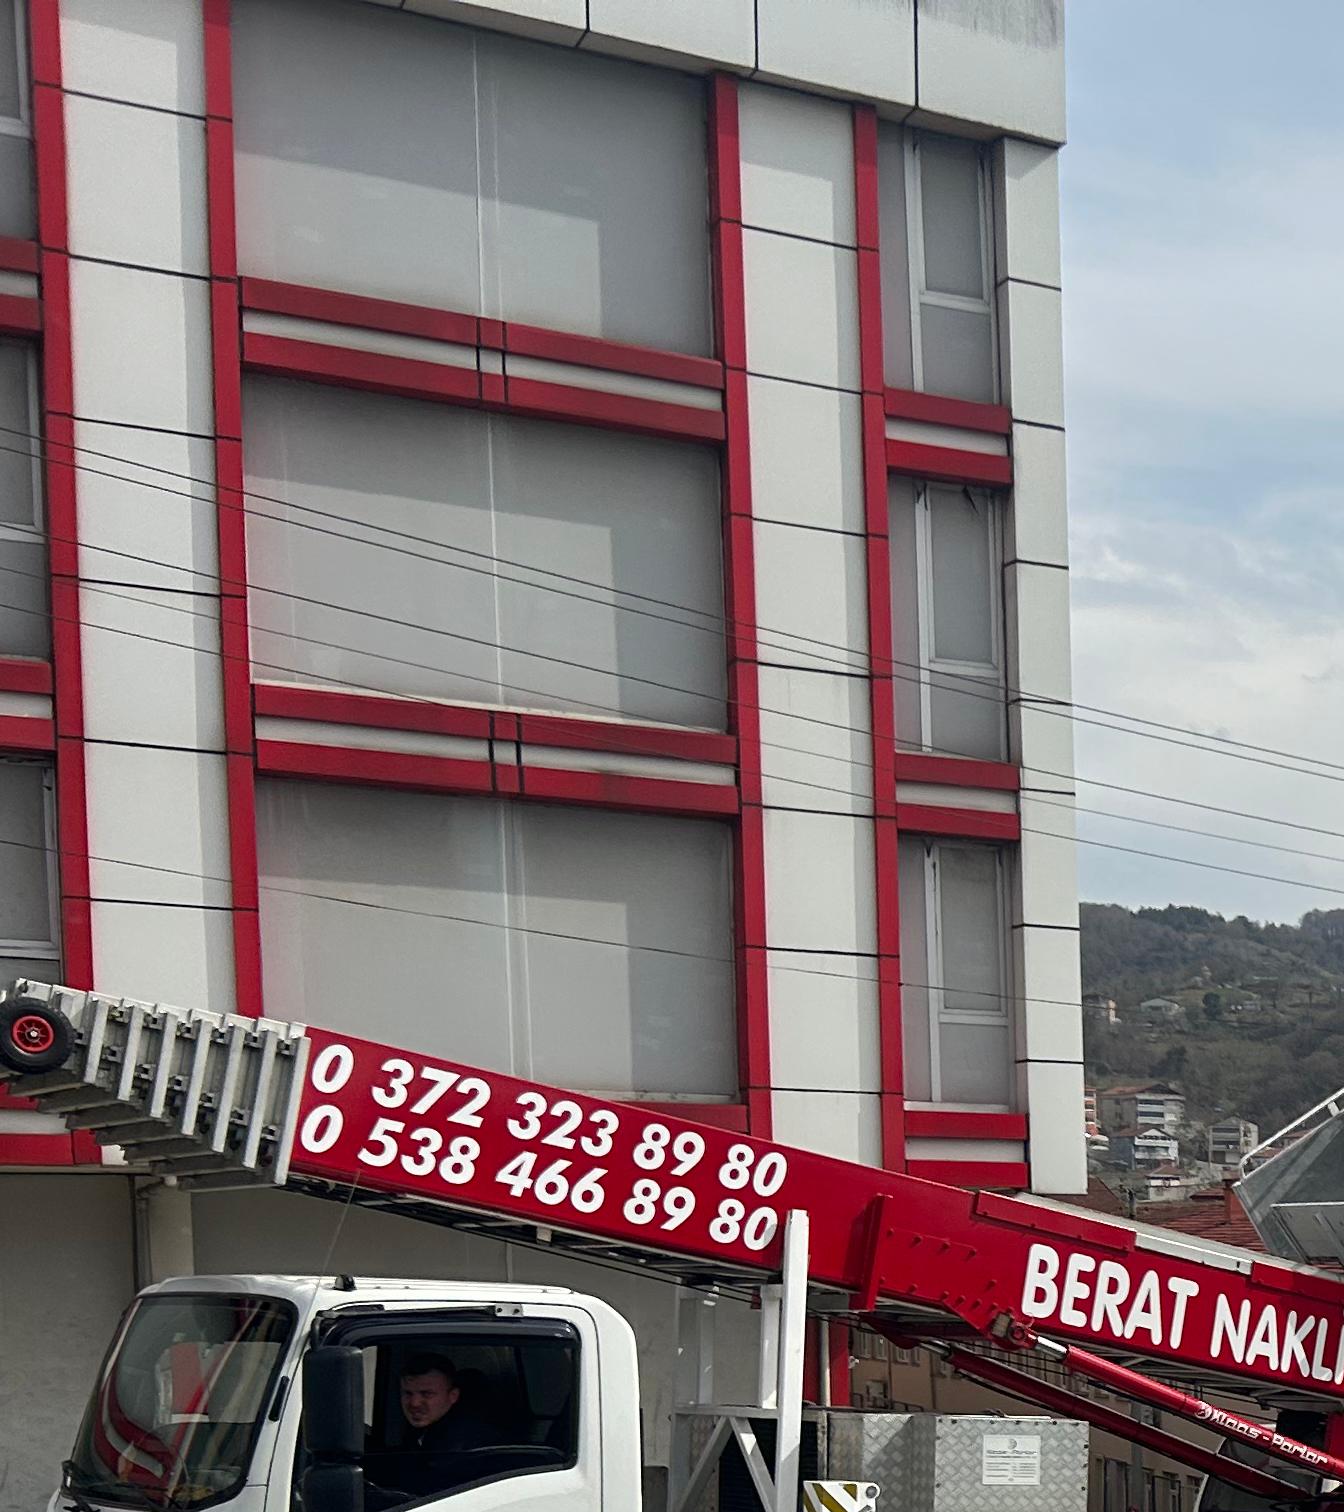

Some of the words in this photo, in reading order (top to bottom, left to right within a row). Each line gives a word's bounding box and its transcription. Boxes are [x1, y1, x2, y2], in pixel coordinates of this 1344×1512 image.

[301, 1104, 343, 1154] 0
[358, 1121, 481, 1186] 538
[496, 1153, 605, 1214] 466
[623, 1178, 696, 1233] 89
[709, 1197, 778, 1251] 80
[311, 1043, 354, 1094] 0
[371, 1059, 491, 1127] 372
[508, 1091, 620, 1157] 323
[633, 1123, 706, 1178] 89
[719, 1143, 788, 1196] 80
[1022, 1243, 1198, 1349] BERAT
